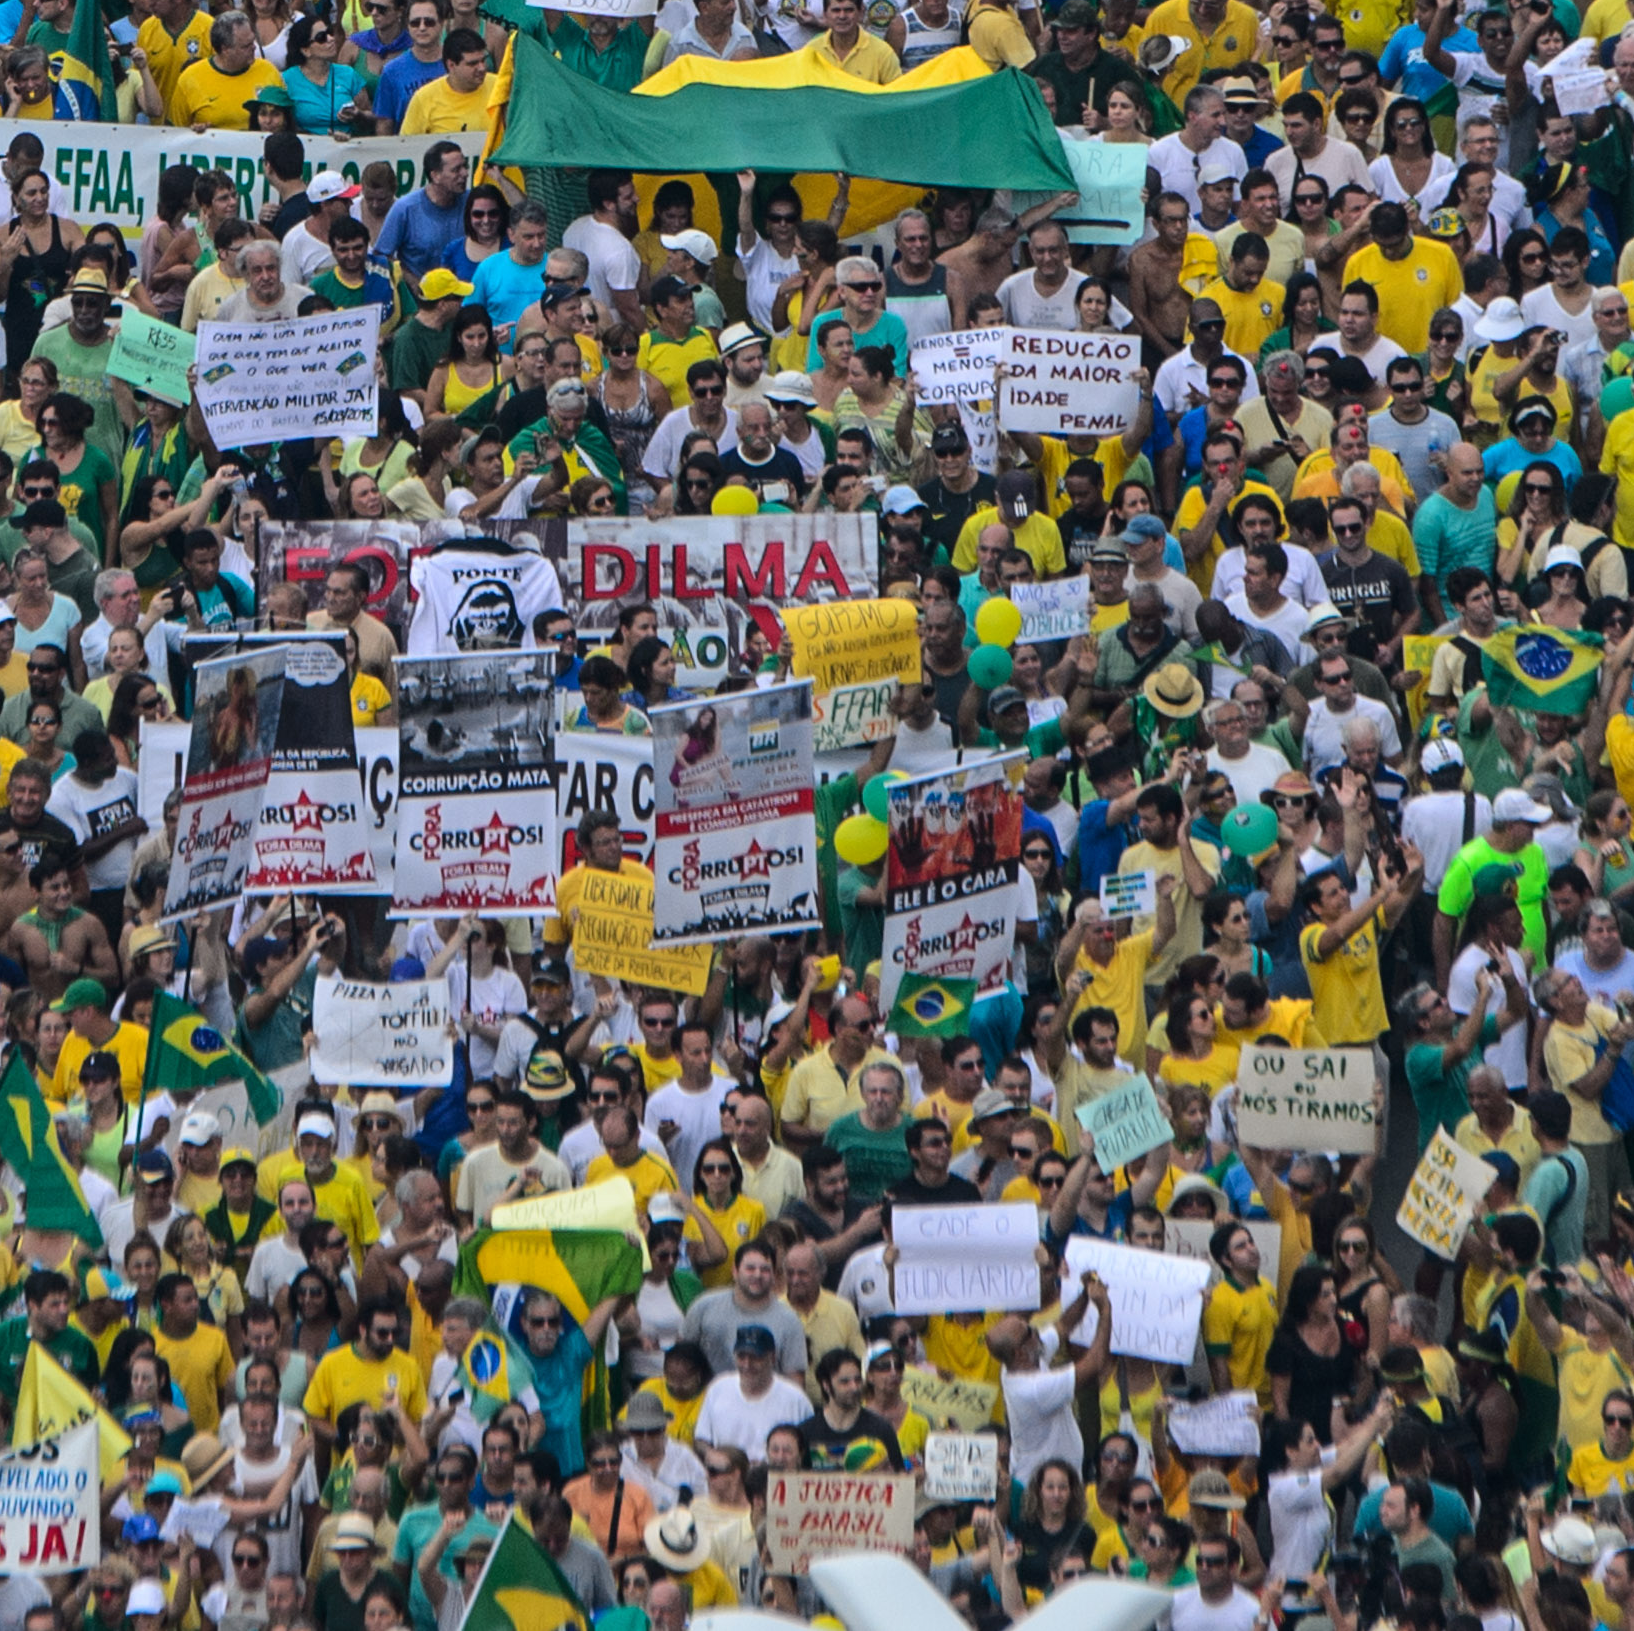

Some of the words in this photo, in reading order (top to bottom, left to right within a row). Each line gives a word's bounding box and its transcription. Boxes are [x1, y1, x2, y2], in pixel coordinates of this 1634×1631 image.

[317, 337, 363, 354] ACEITAR
[1011, 333, 1133, 361] REDUÇÃO
[933, 355, 996, 375] MENOS
[1010, 364, 1037, 382] DA
[1049, 364, 1121, 385] MAIOR
[285, 390, 338, 409] MILITAR
[1009, 389, 1069, 408] IDADE
[1059, 413, 1128, 430] PENAL
[451, 565, 522, 585] PONTE
[580, 539, 851, 601] DILMA
[797, 601, 899, 640] GOLPISMO
[401, 772, 504, 794] CORRUPÇÃO
[507, 768, 551, 787] MATA
[409, 823, 544, 852] CORRUPTOS!
[668, 845, 804, 885] CORRUPTOS!
[893, 891, 922, 911] ELE
[926, 885, 937, 905] É
[941, 884, 957, 901] O
[960, 868, 1008, 896] CARA
[332, 983, 376, 1001] PIZZA
[381, 987, 392, 1001] A
[1253, 1055, 1285, 1075] OU
[1303, 1053, 1347, 1081] SAI
[1285, 1093, 1374, 1125] TIRAMOS
[994, 1211, 1010, 1236] O
[771, 1478, 787, 1506] A
